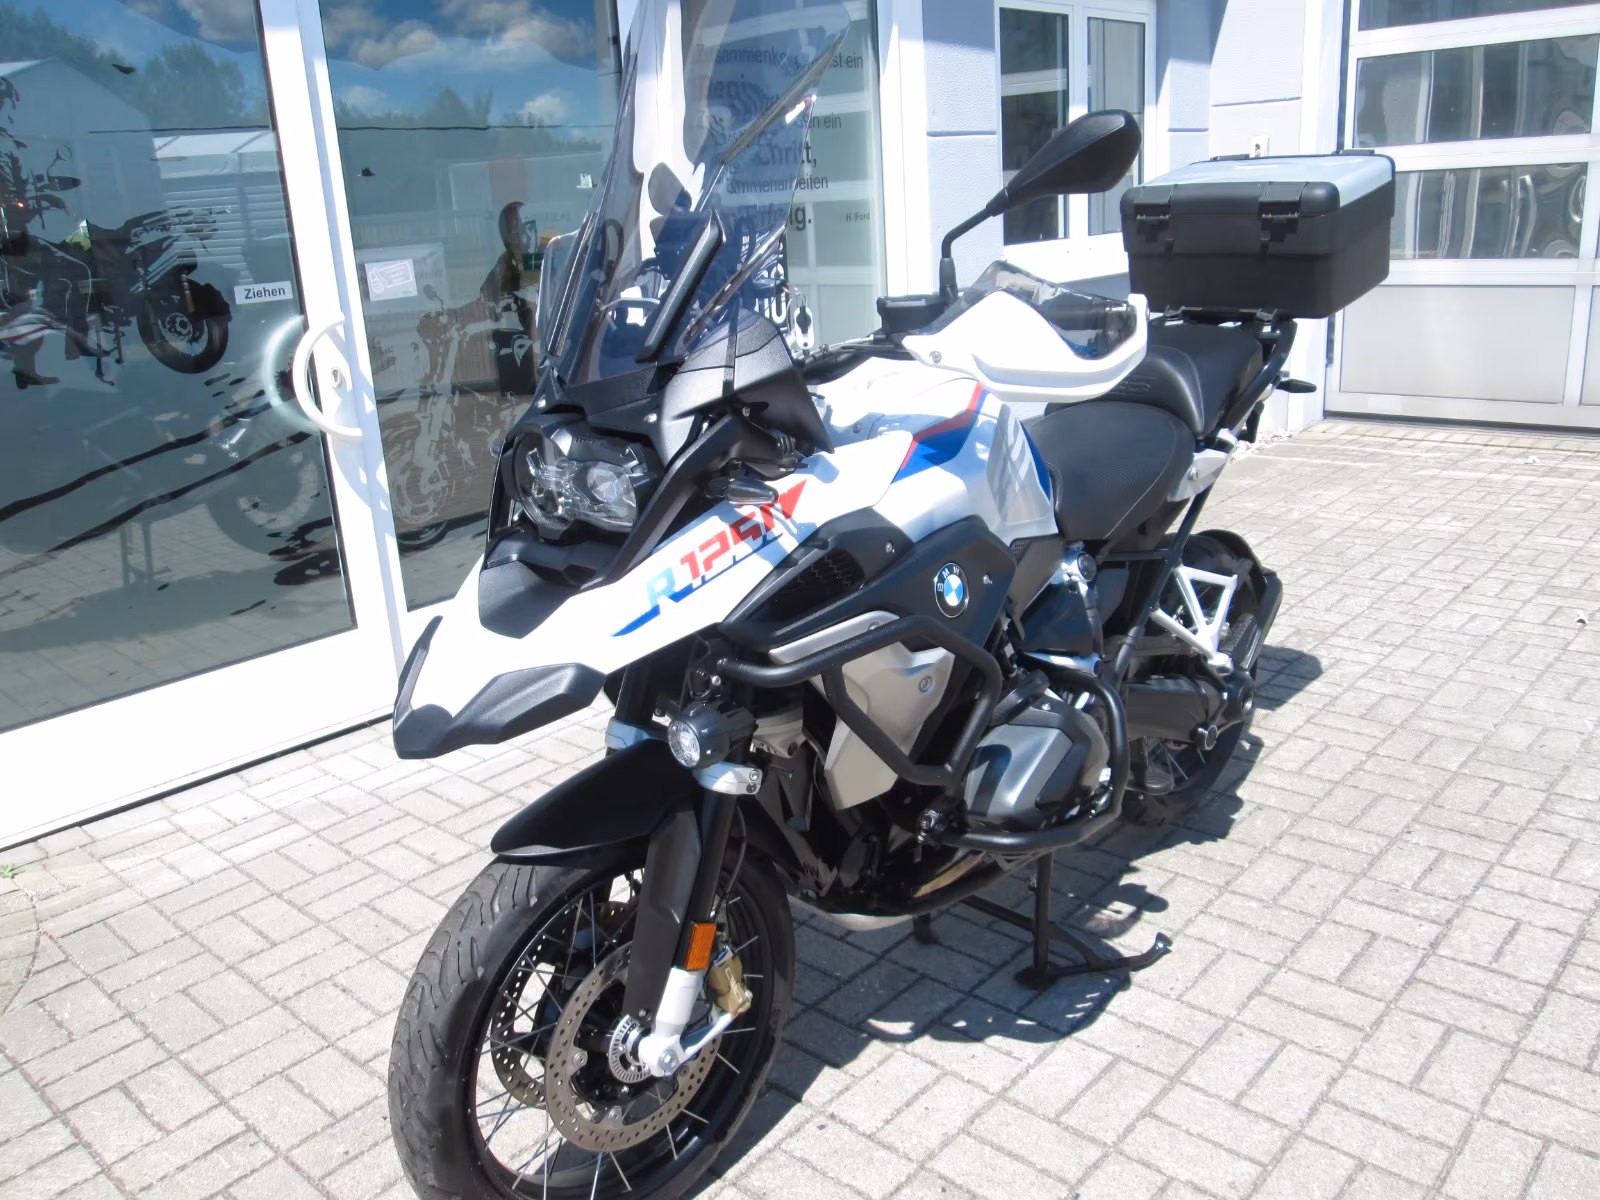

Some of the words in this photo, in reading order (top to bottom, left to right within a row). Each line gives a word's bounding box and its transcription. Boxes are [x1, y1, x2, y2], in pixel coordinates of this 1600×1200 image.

[846, 52, 864, 69] ein
[823, 112, 842, 129] ein
[244, 286, 286, 300] Ziehen
[937, 566, 960, 592] BMW
